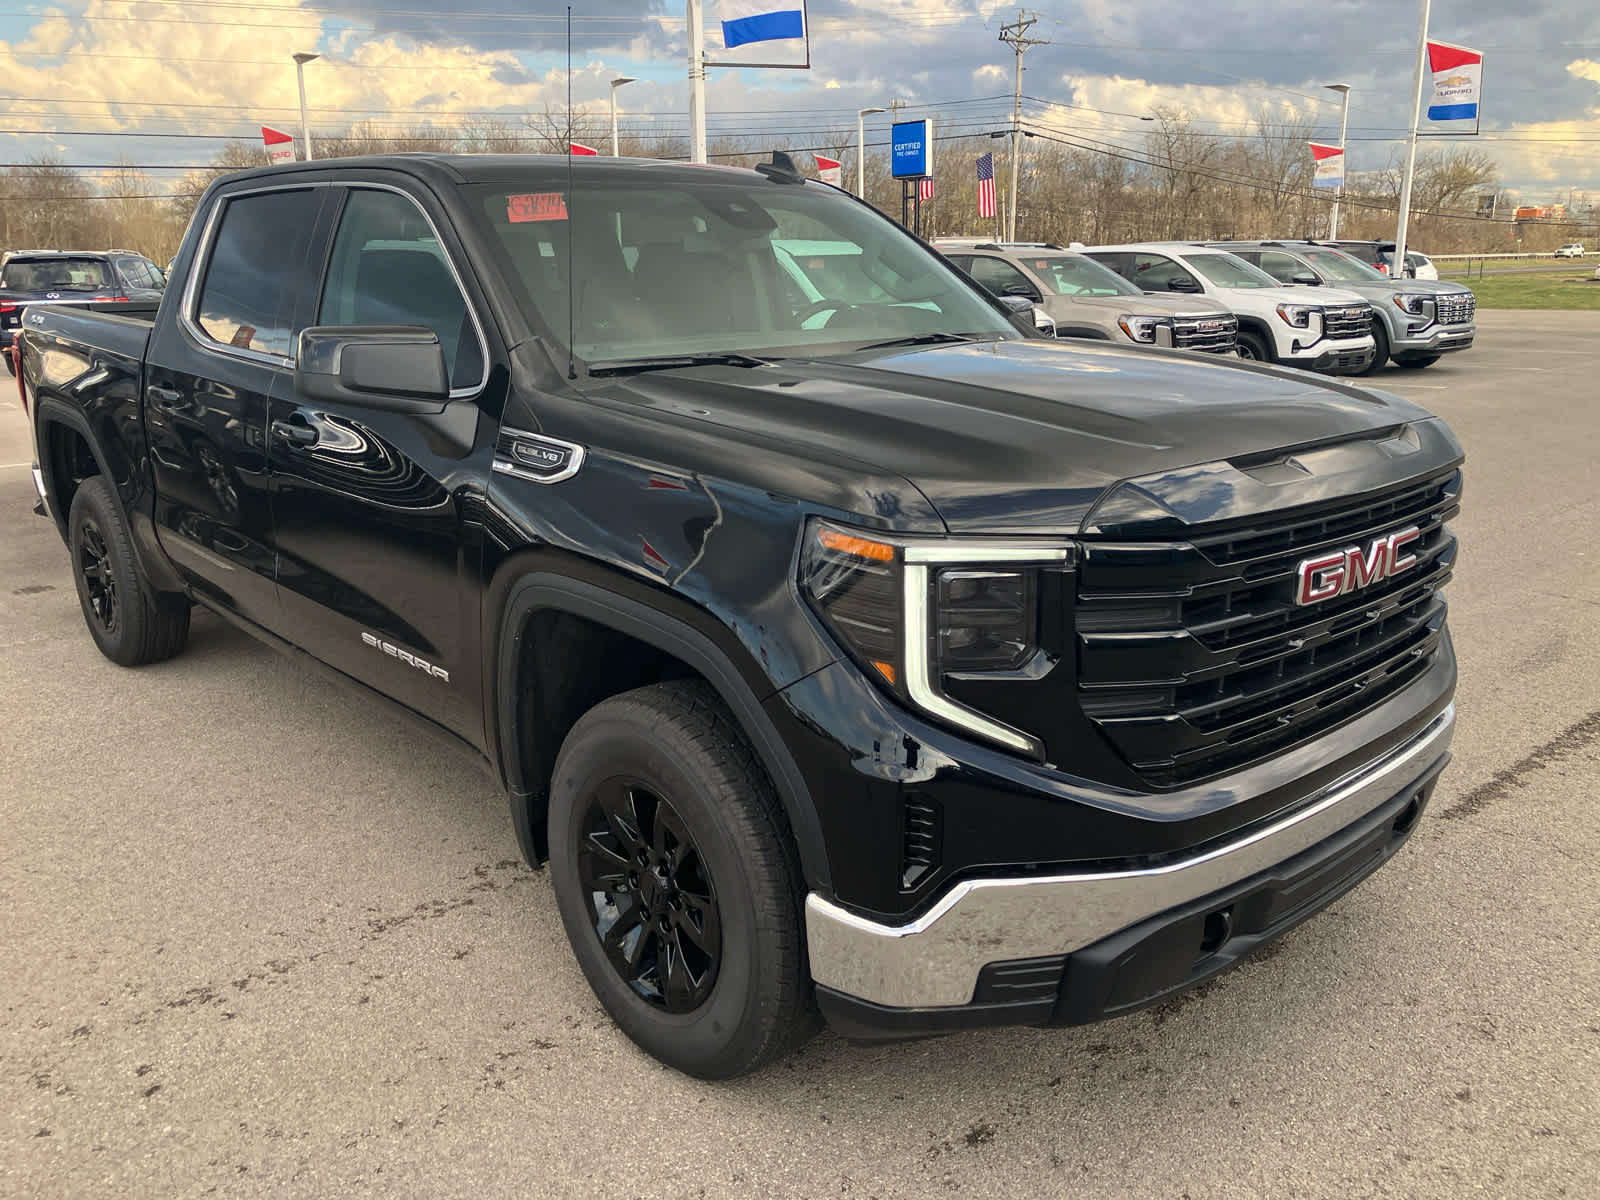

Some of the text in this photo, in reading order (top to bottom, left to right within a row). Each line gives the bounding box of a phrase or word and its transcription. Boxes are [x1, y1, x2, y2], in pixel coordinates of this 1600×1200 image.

[894, 142, 921, 151] CERTIFIED
[542, 451, 558, 461] V8
[1296, 526, 1420, 606] GMC
[361, 632, 449, 682] SIERRA
